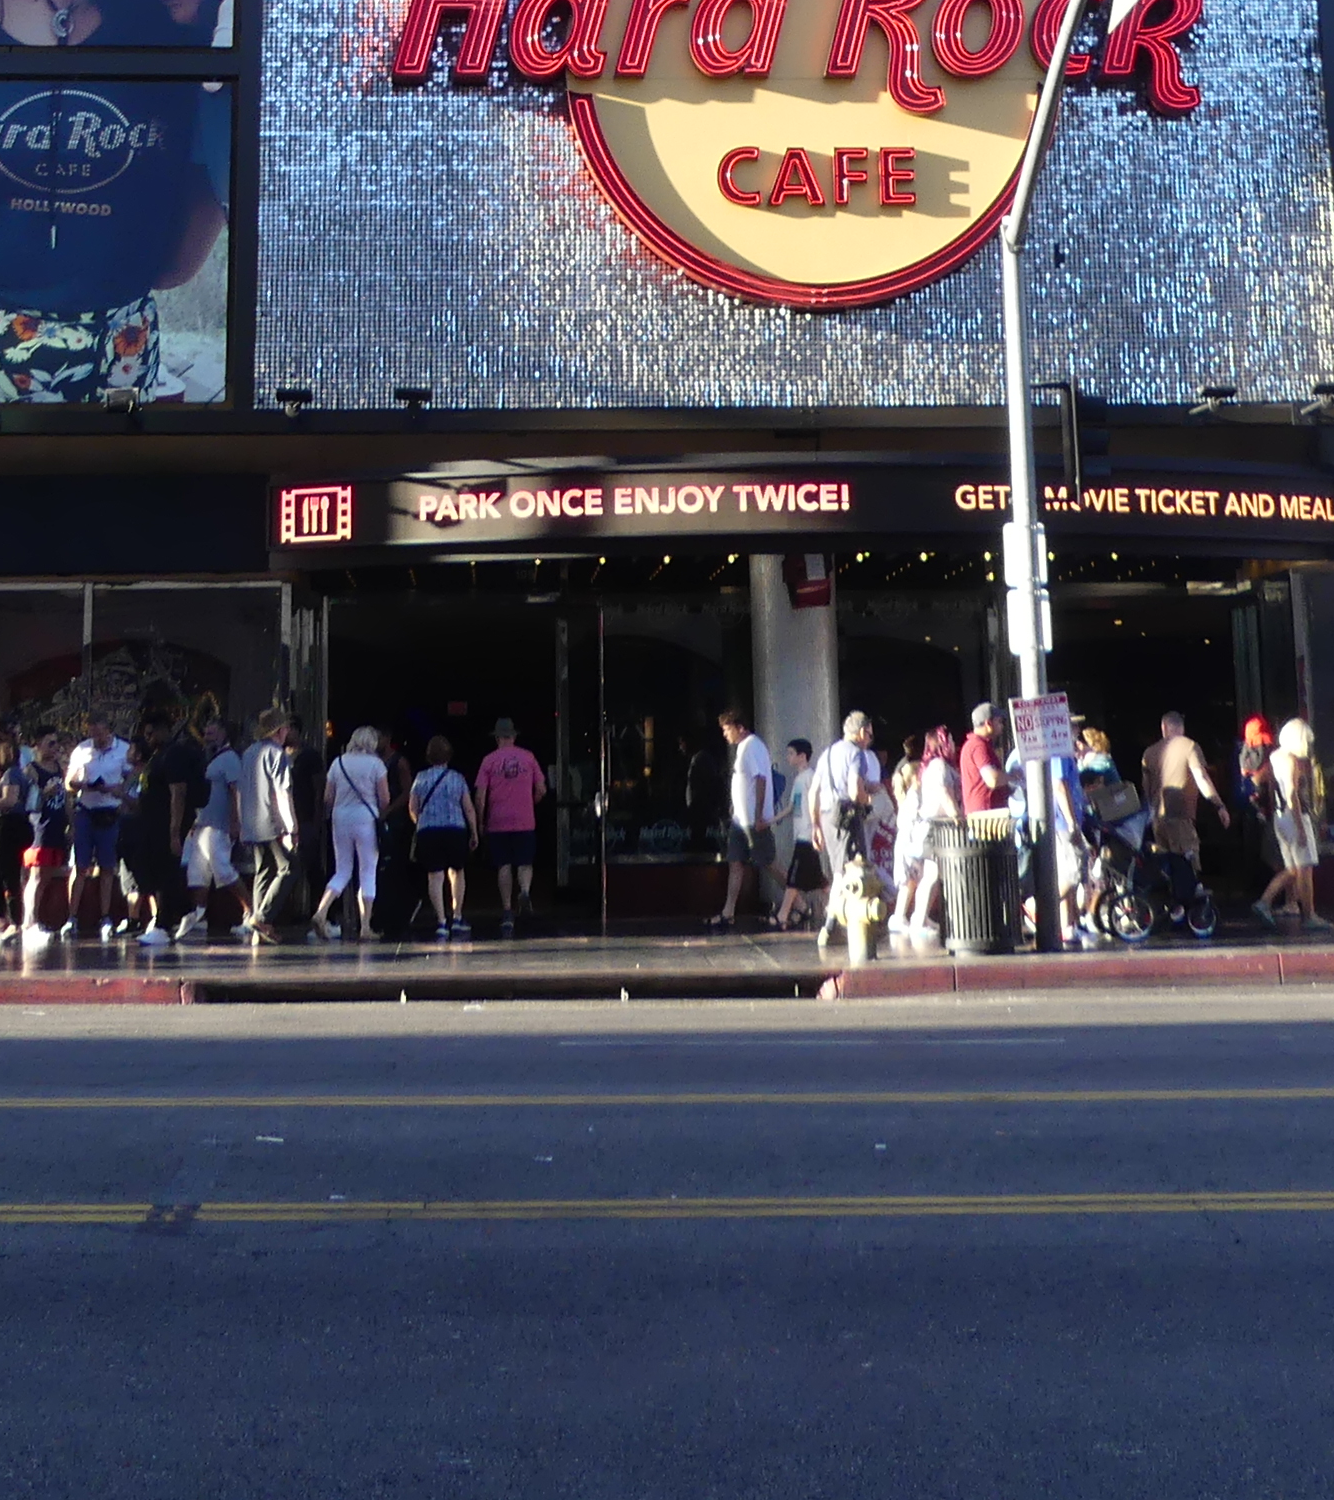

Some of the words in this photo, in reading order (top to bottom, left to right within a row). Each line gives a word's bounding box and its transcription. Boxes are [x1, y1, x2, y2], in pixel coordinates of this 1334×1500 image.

[66, 108, 169, 159] Rock
[33, 162, 92, 177] CAFE
[717, 145, 919, 207] CAFE
[418, 491, 501, 522] PARK
[509, 488, 605, 518] ONCE
[613, 485, 725, 515] ENJOY
[732, 483, 851, 513] TWICE!
[955, 485, 1011, 510] GET
[1134, 488, 1220, 516] TICKET
[1224, 492, 1276, 518] AND
[1015, 715, 1034, 732] NO
